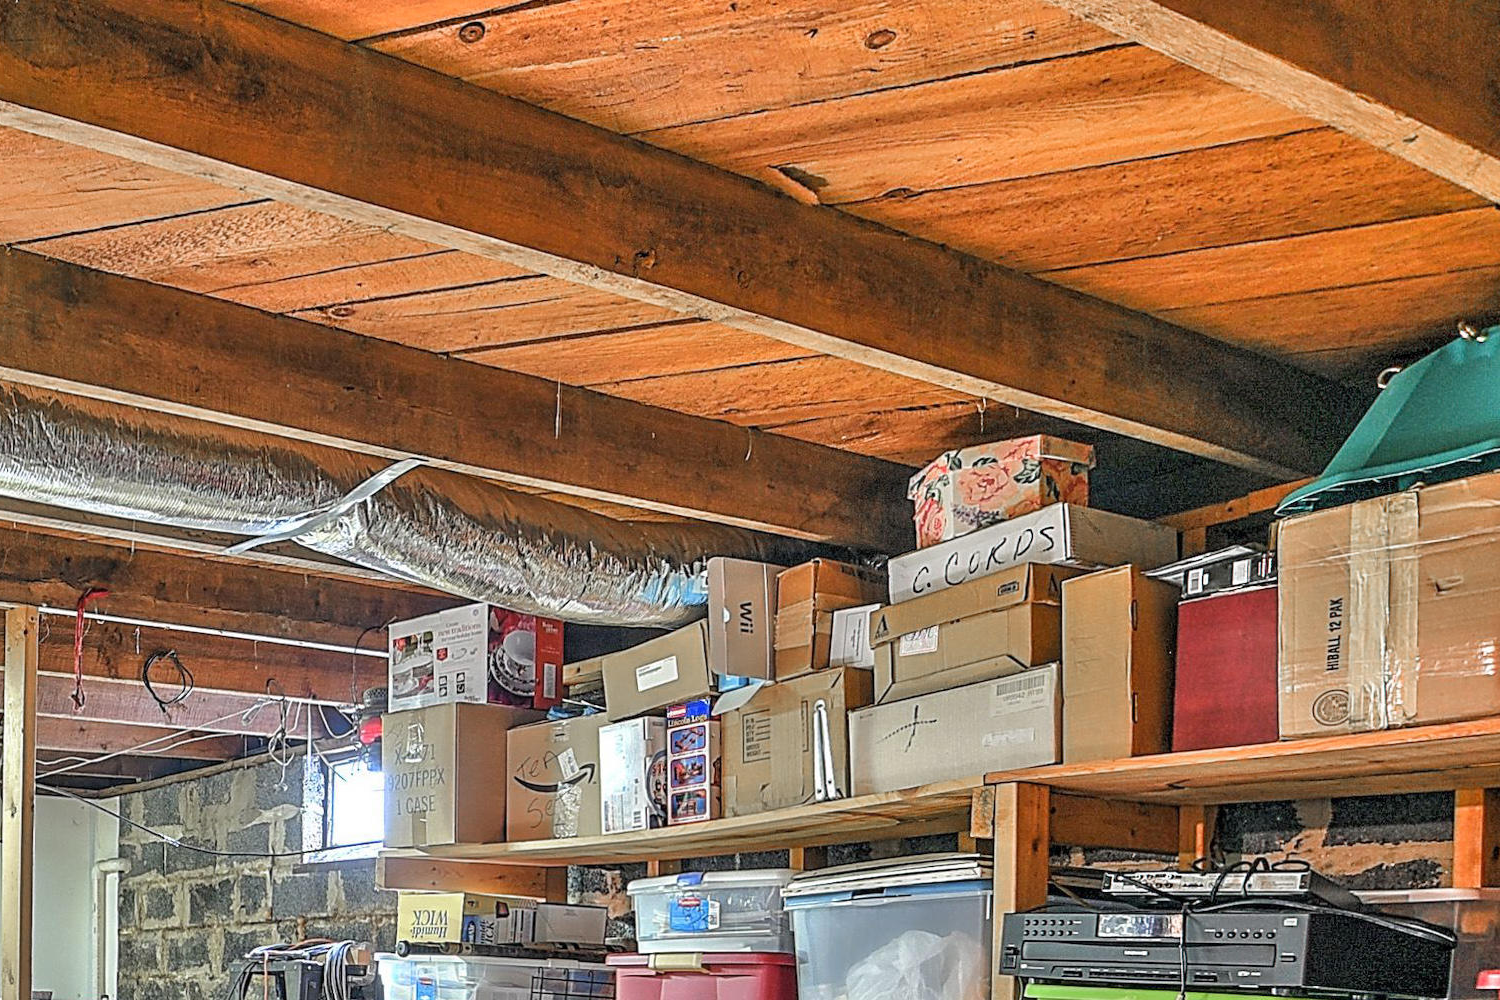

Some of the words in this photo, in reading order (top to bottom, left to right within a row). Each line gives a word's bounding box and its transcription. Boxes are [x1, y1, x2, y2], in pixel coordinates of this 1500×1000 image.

[739, 602, 753, 634] Wii
[1329, 597, 1343, 619] PAK
[1330, 620, 1342, 633] 12
[1326, 635, 1342, 672] HIBALL
[406, 795, 436, 814] CASE
[411, 909, 448, 926] WICK
